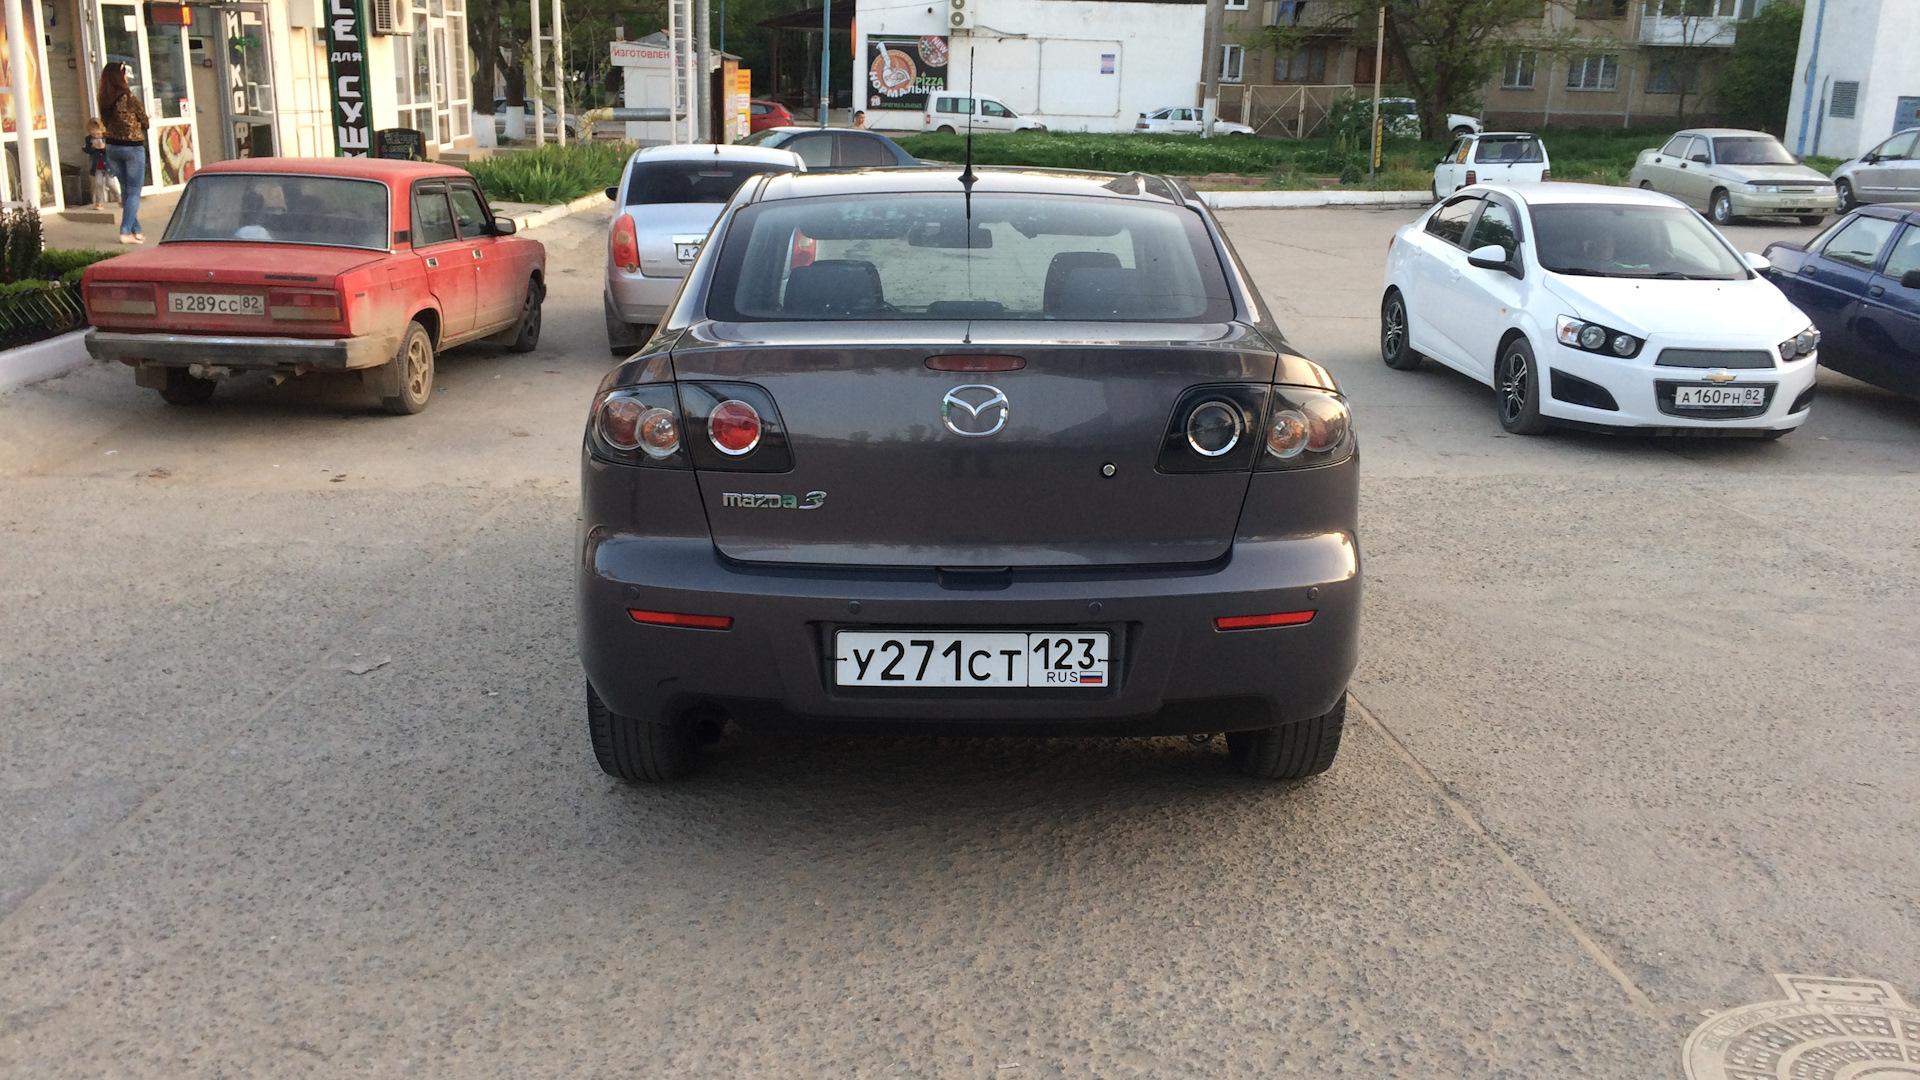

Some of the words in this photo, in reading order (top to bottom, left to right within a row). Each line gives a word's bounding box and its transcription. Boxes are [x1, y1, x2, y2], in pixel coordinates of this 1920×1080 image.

[931, 36, 948, 53] NEW
[613, 48, 671, 59] ИЗГОТОВЛЕН
[916, 73, 944, 86] PIZZA
[338, 76, 369, 157] СУШ
[799, 490, 827, 510] 3
[1033, 638, 1096, 670] 123
[1046, 671, 1078, 682] RUS
